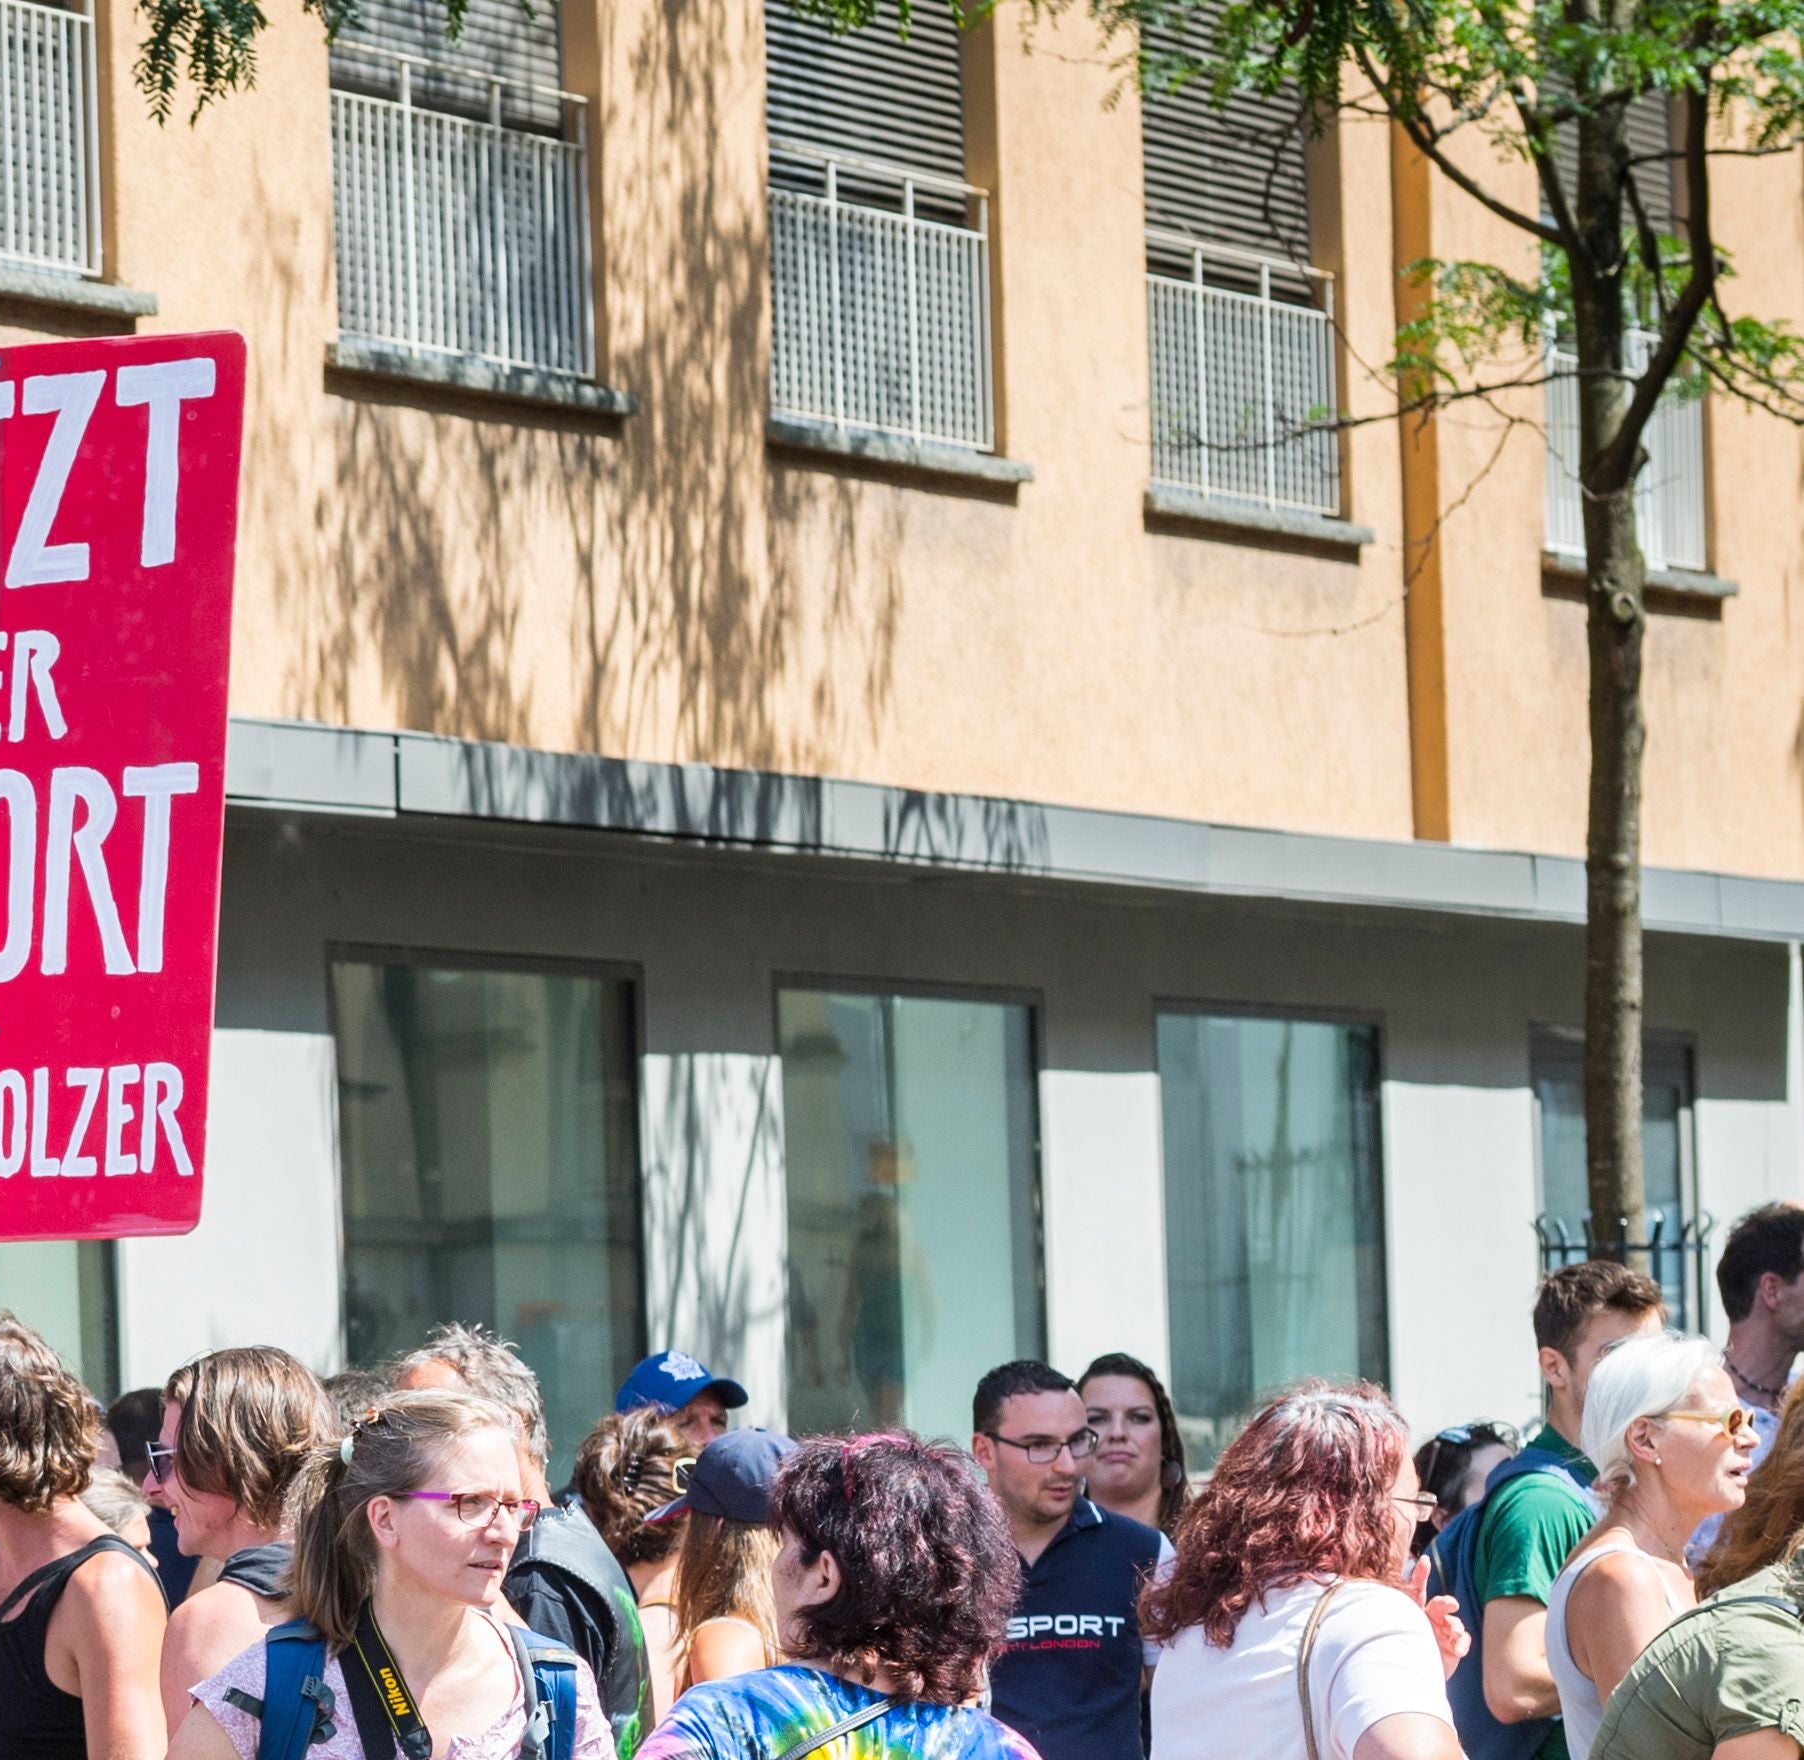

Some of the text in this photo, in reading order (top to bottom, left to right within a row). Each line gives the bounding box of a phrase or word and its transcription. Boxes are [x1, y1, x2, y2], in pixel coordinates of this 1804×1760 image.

[1006, 1614, 1125, 1639] SPORT
[1029, 1639, 1101, 1650] LONDON
[379, 1667, 411, 1716] Nikon
